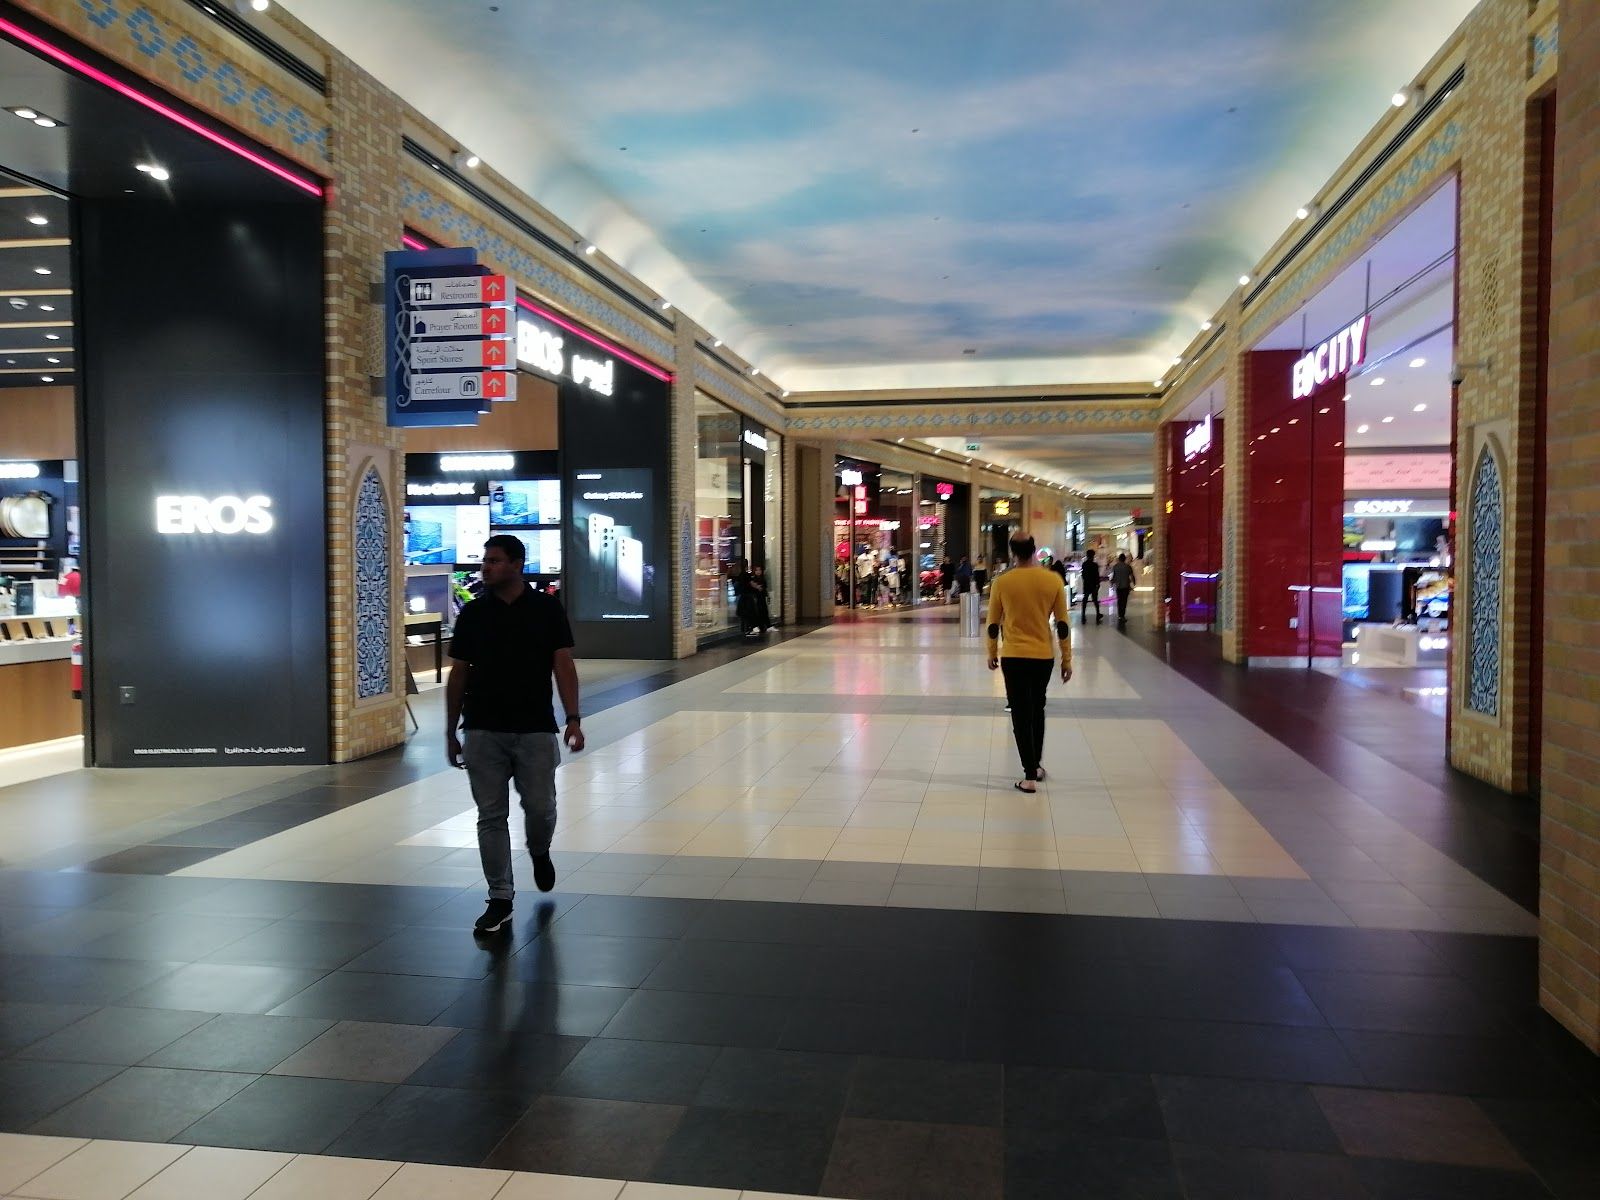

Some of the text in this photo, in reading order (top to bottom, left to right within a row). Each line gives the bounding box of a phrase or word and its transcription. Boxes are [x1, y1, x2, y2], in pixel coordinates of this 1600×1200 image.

[441, 291, 478, 300] Restrooms
[429, 322, 478, 333] Prayer Rooms
[517, 320, 563, 375] EROS
[416, 354, 464, 365] Sport Stores
[414, 386, 451, 395] Carrefour
[1354, 500, 1413, 513] SONY
[157, 496, 272, 534] EROS
